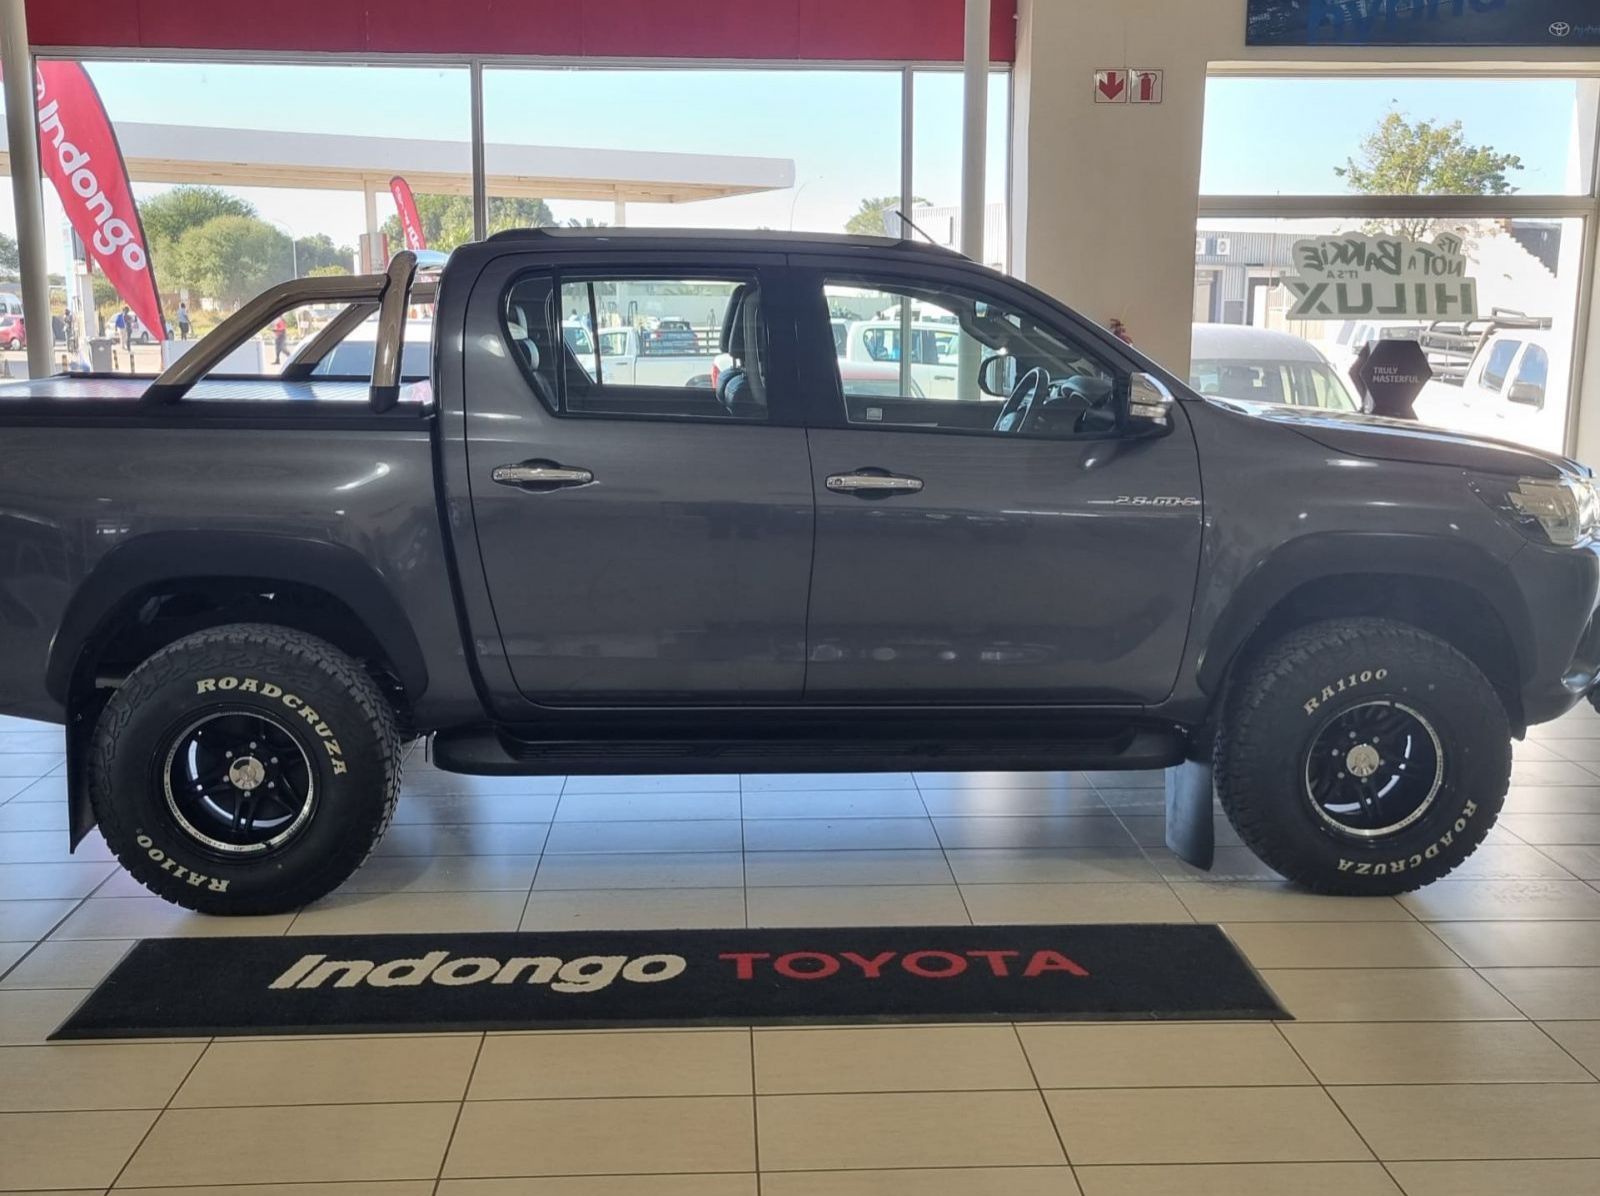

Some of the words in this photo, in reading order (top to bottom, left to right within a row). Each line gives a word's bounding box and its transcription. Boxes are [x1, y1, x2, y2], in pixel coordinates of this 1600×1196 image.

[39, 99, 147, 271] Indongo
[1372, 375, 1420, 383] MASTERFUL
[1373, 366, 1398, 374] TRULY
[1303, 668, 1388, 716] RA1100
[196, 676, 347, 776] ROADCRUZA
[136, 834, 231, 893] RA1100
[1337, 799, 1478, 875] ROADCRUZA
[268, 951, 686, 992] Indongo
[718, 950, 1090, 979] TOYOTA
